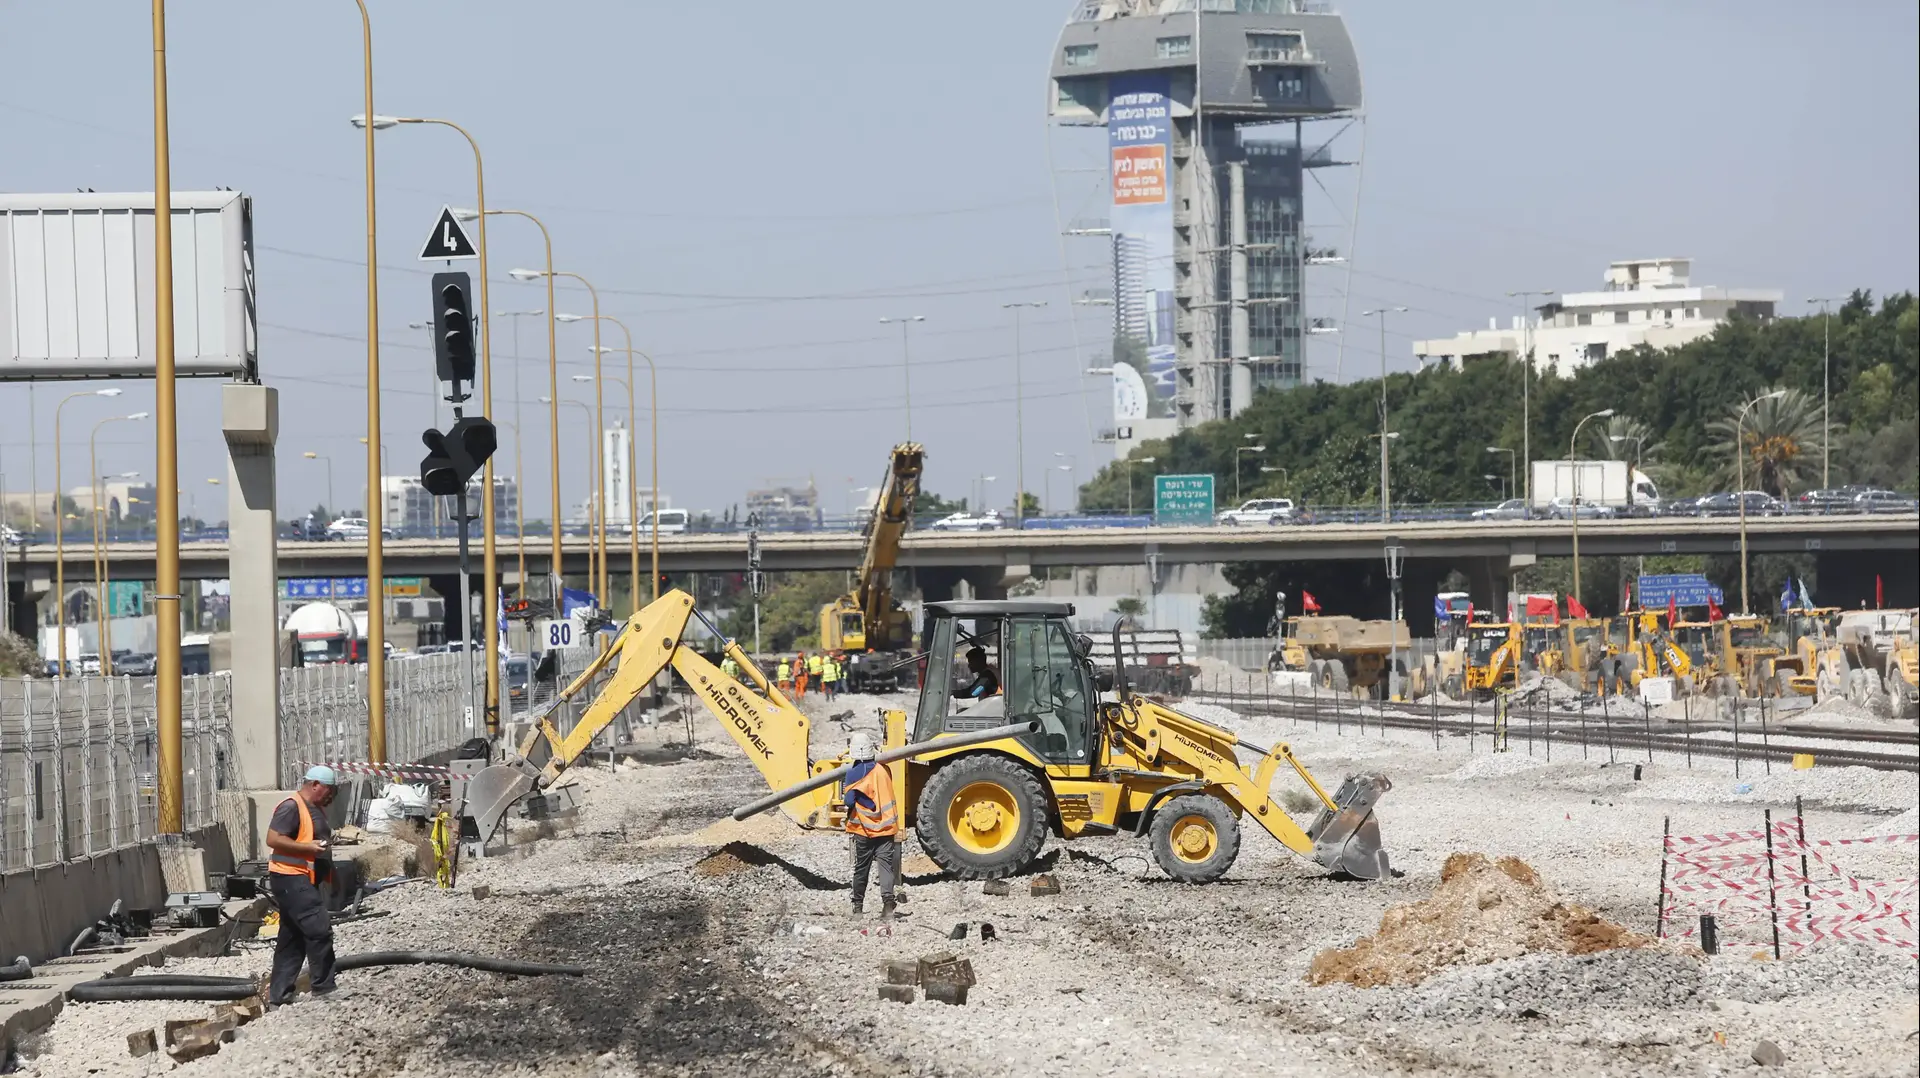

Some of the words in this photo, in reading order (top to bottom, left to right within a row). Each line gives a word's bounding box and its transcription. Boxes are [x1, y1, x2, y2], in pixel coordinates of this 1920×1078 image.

[1114, 156, 1132, 176] לציון
[1134, 157, 1162, 175] ראשון
[443, 221, 458, 252] 4
[1164, 480, 1185, 489] רוקח
[1161, 490, 1209, 499] אוניברסיטה
[549, 622, 571, 646] 80
